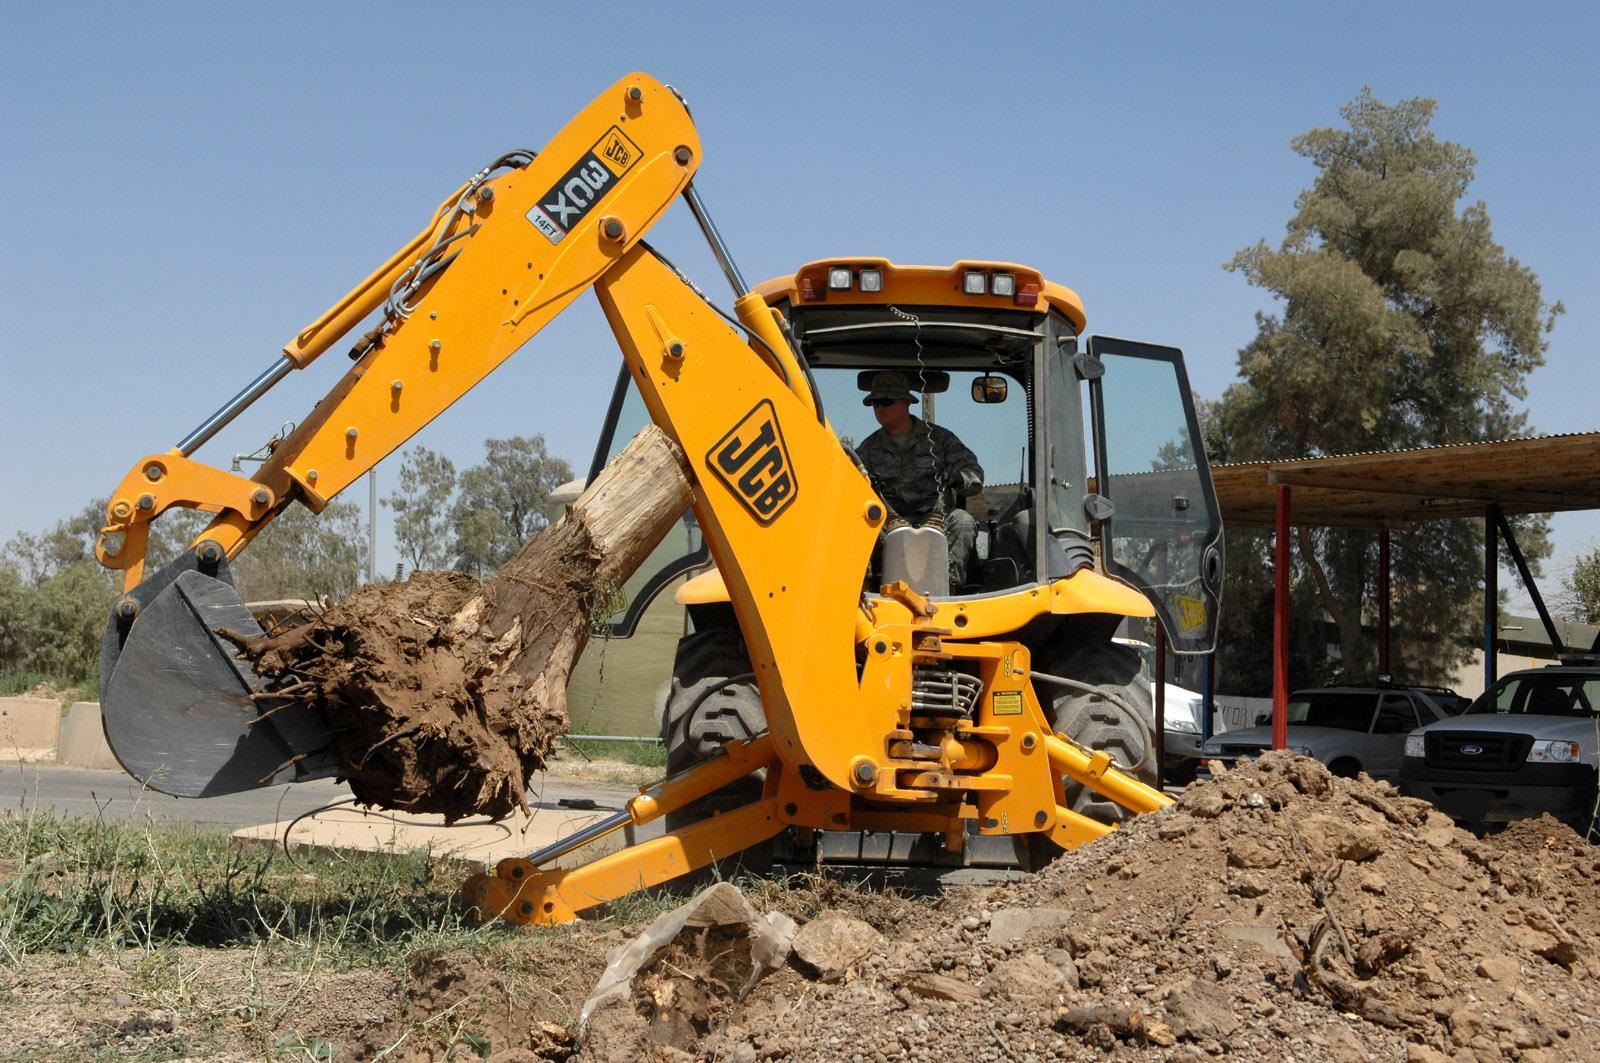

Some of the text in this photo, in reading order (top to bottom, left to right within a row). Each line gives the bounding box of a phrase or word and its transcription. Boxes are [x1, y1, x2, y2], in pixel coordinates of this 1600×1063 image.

[606, 139, 629, 165] JCB
[544, 160, 609, 228] 3CX
[534, 215, 557, 236] 14FT
[717, 419, 791, 515] JCB
